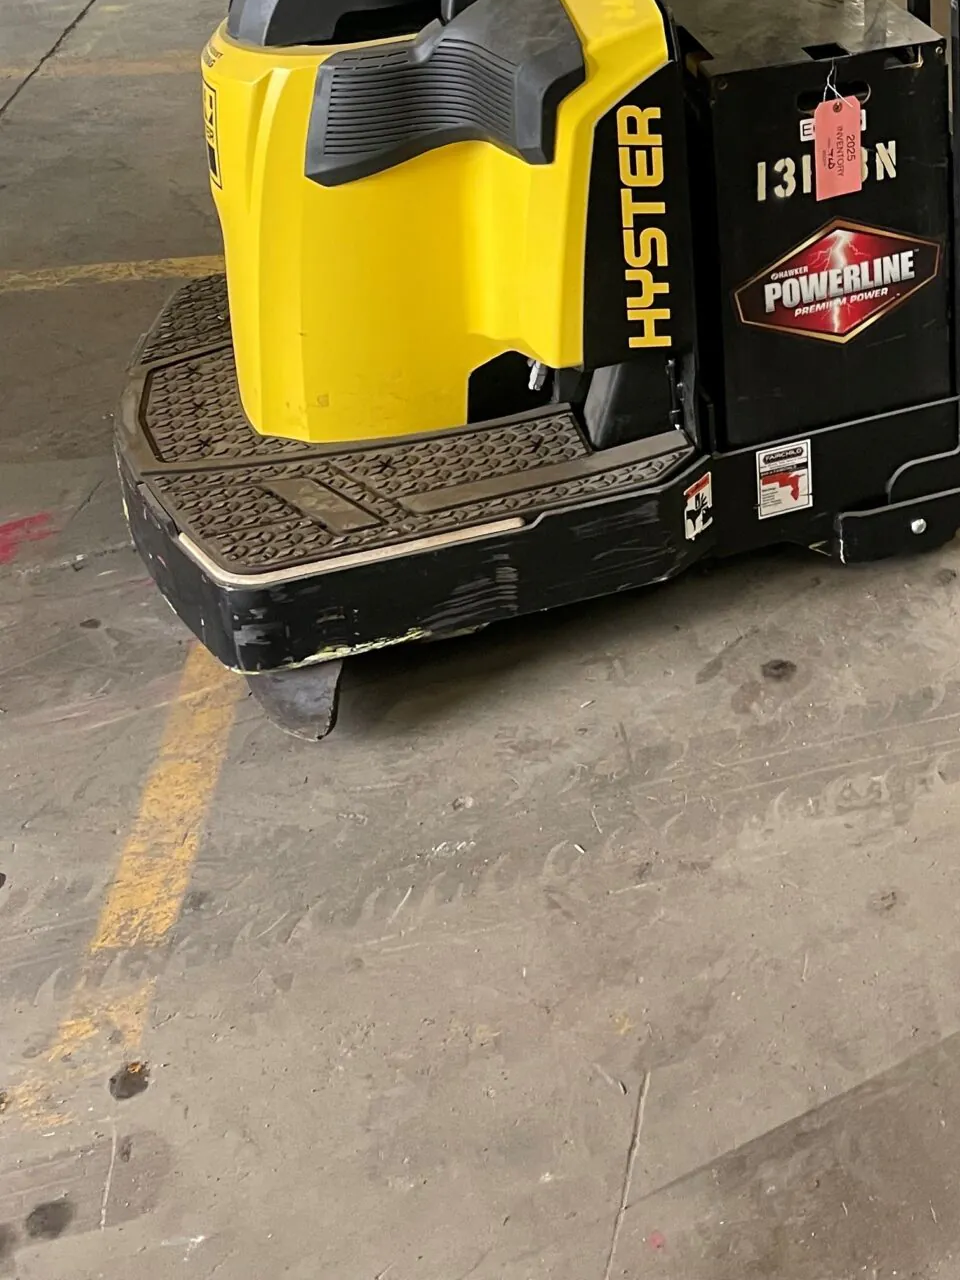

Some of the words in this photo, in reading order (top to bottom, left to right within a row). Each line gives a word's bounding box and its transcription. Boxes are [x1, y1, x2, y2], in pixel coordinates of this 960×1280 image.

[835, 125, 845, 177] INVENTORY
[846, 134, 856, 162] 2025
[616, 104, 672, 348] HYSTER
[763, 249, 916, 314] POWERLINE
[778, 265, 809, 279] HAWKER
[850, 287, 889, 305] POWER
